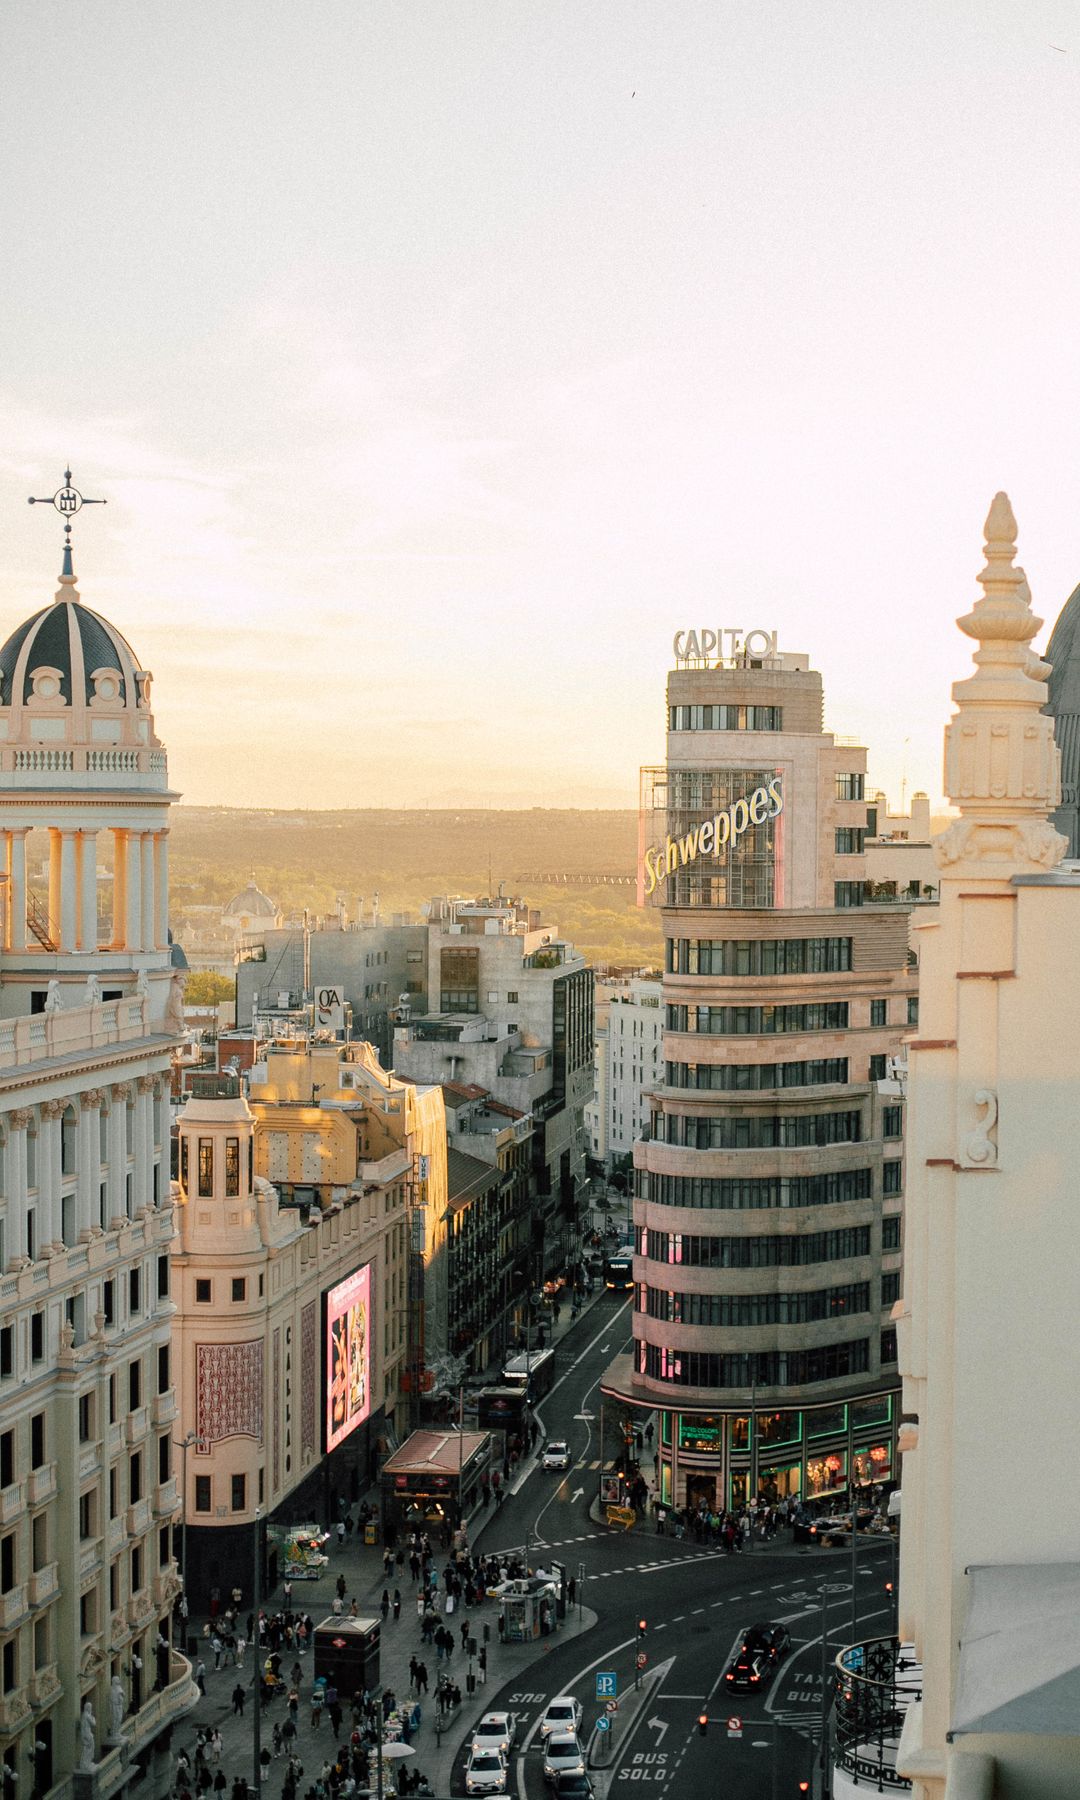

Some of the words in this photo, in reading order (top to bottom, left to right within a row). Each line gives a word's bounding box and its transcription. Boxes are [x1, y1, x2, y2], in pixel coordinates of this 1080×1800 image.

[673, 628, 784, 660] CAPITOL
[644, 777, 783, 895] Schweppes
[601, 1677, 613, 1693] P
[793, 1673, 833, 1685] TAXI
[509, 1693, 547, 1703] BUS
[786, 1691, 823, 1702] BUS
[632, 1753, 669, 1764] BUS
[618, 1768, 667, 1780] SOLO
